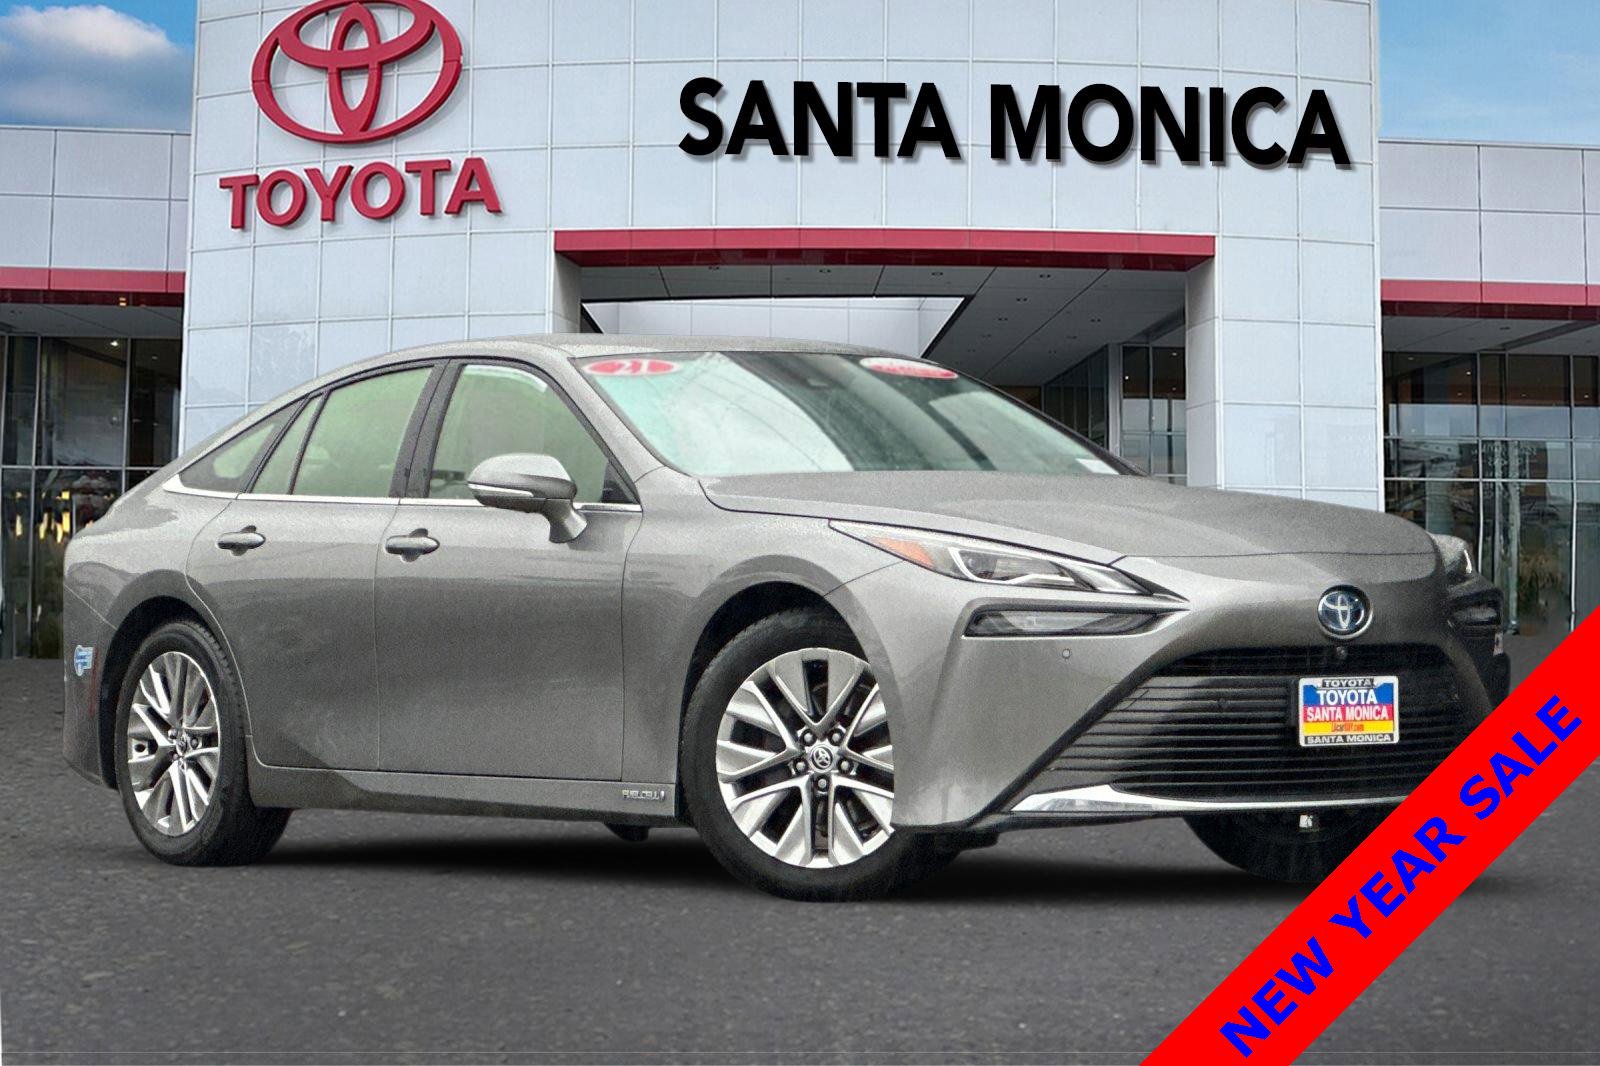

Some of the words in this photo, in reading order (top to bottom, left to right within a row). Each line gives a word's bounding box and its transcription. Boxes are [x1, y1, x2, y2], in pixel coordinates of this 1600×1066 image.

[678, 78, 961, 158] SANTA
[990, 83, 1351, 166] MONICA
[219, 157, 502, 229] TOYOTA
[1324, 679, 1372, 688] TOYOTA
[1316, 689, 1378, 705] TOYOTA
[1307, 706, 1344, 721] SANTA
[1345, 705, 1389, 721] MONICA
[1307, 735, 1344, 744] SANTA
[1346, 733, 1392, 743] MONICA
